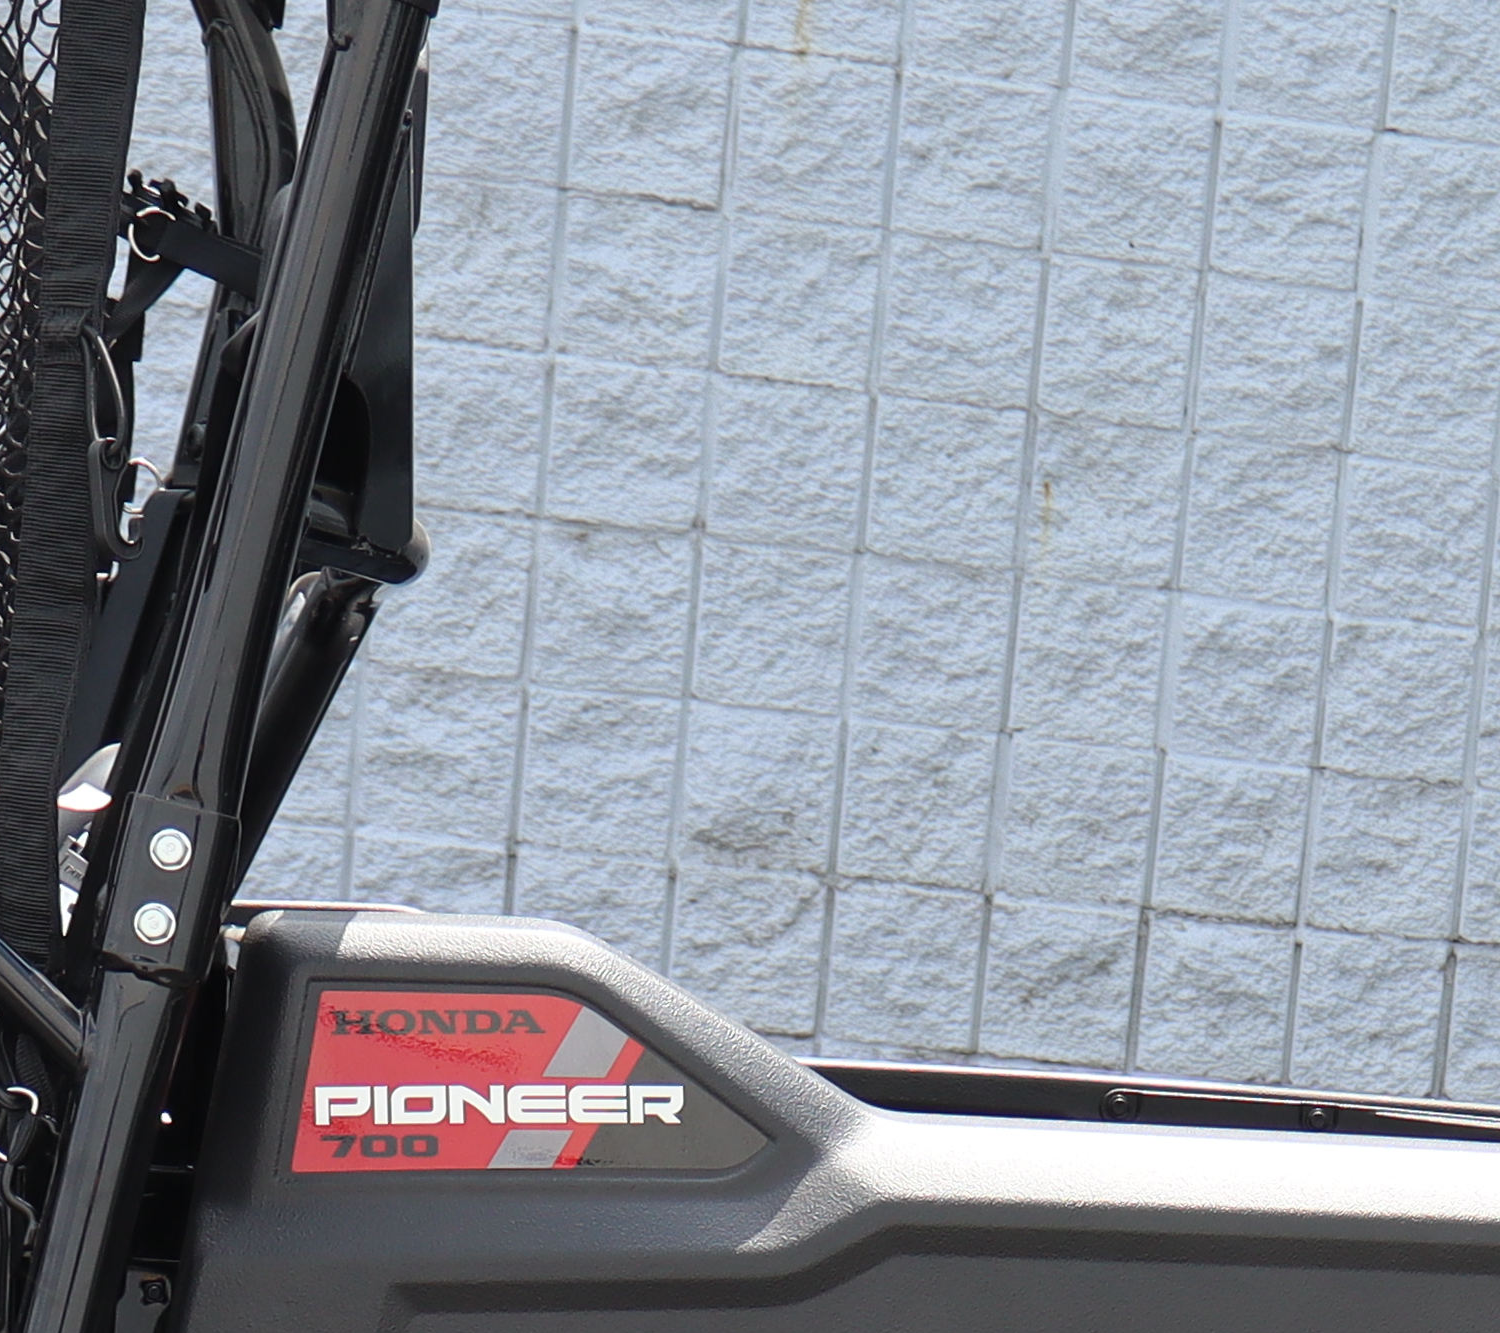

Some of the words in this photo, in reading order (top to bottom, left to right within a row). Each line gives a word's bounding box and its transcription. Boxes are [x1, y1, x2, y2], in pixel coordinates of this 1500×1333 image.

[330, 1009, 544, 1035] HONDA
[314, 1085, 684, 1125] PIONEER
[320, 1135, 438, 1158] 700
